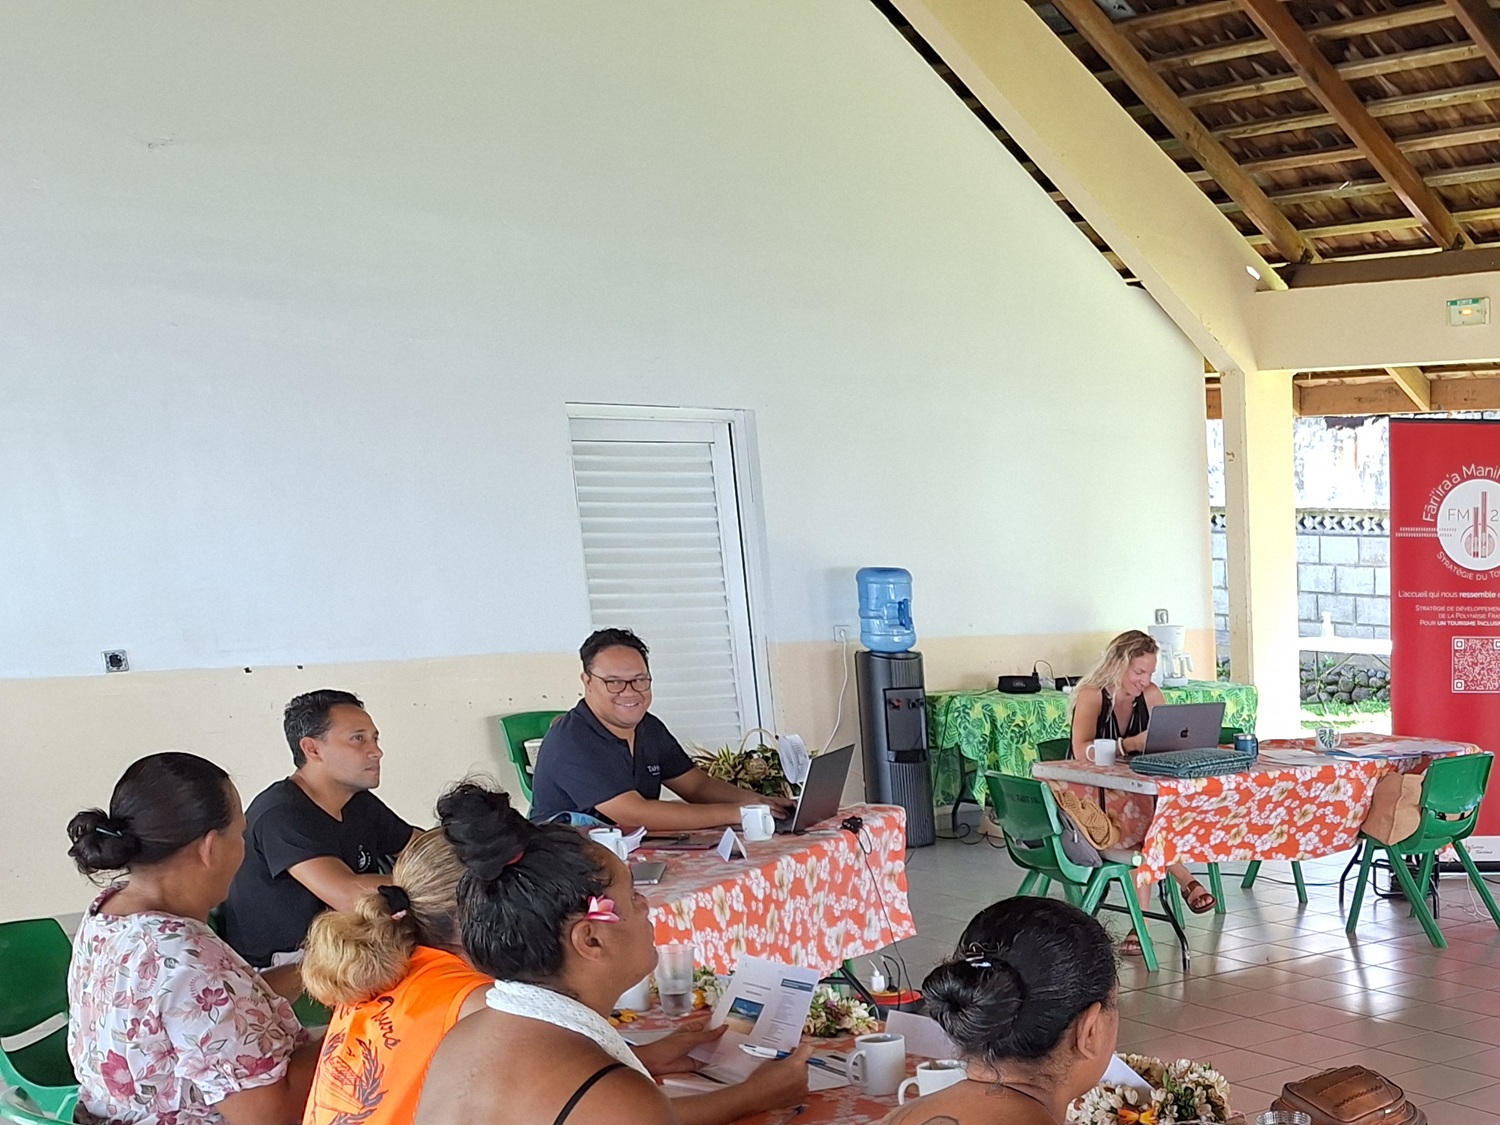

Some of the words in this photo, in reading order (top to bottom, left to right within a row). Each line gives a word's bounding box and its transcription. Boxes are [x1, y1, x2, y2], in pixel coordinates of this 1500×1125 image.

[1448, 508, 1470, 521] FM
[1436, 551, 1474, 580] STRATÉGIE
[1429, 591, 1440, 600] qui
[1459, 591, 1496, 599] ressemble
